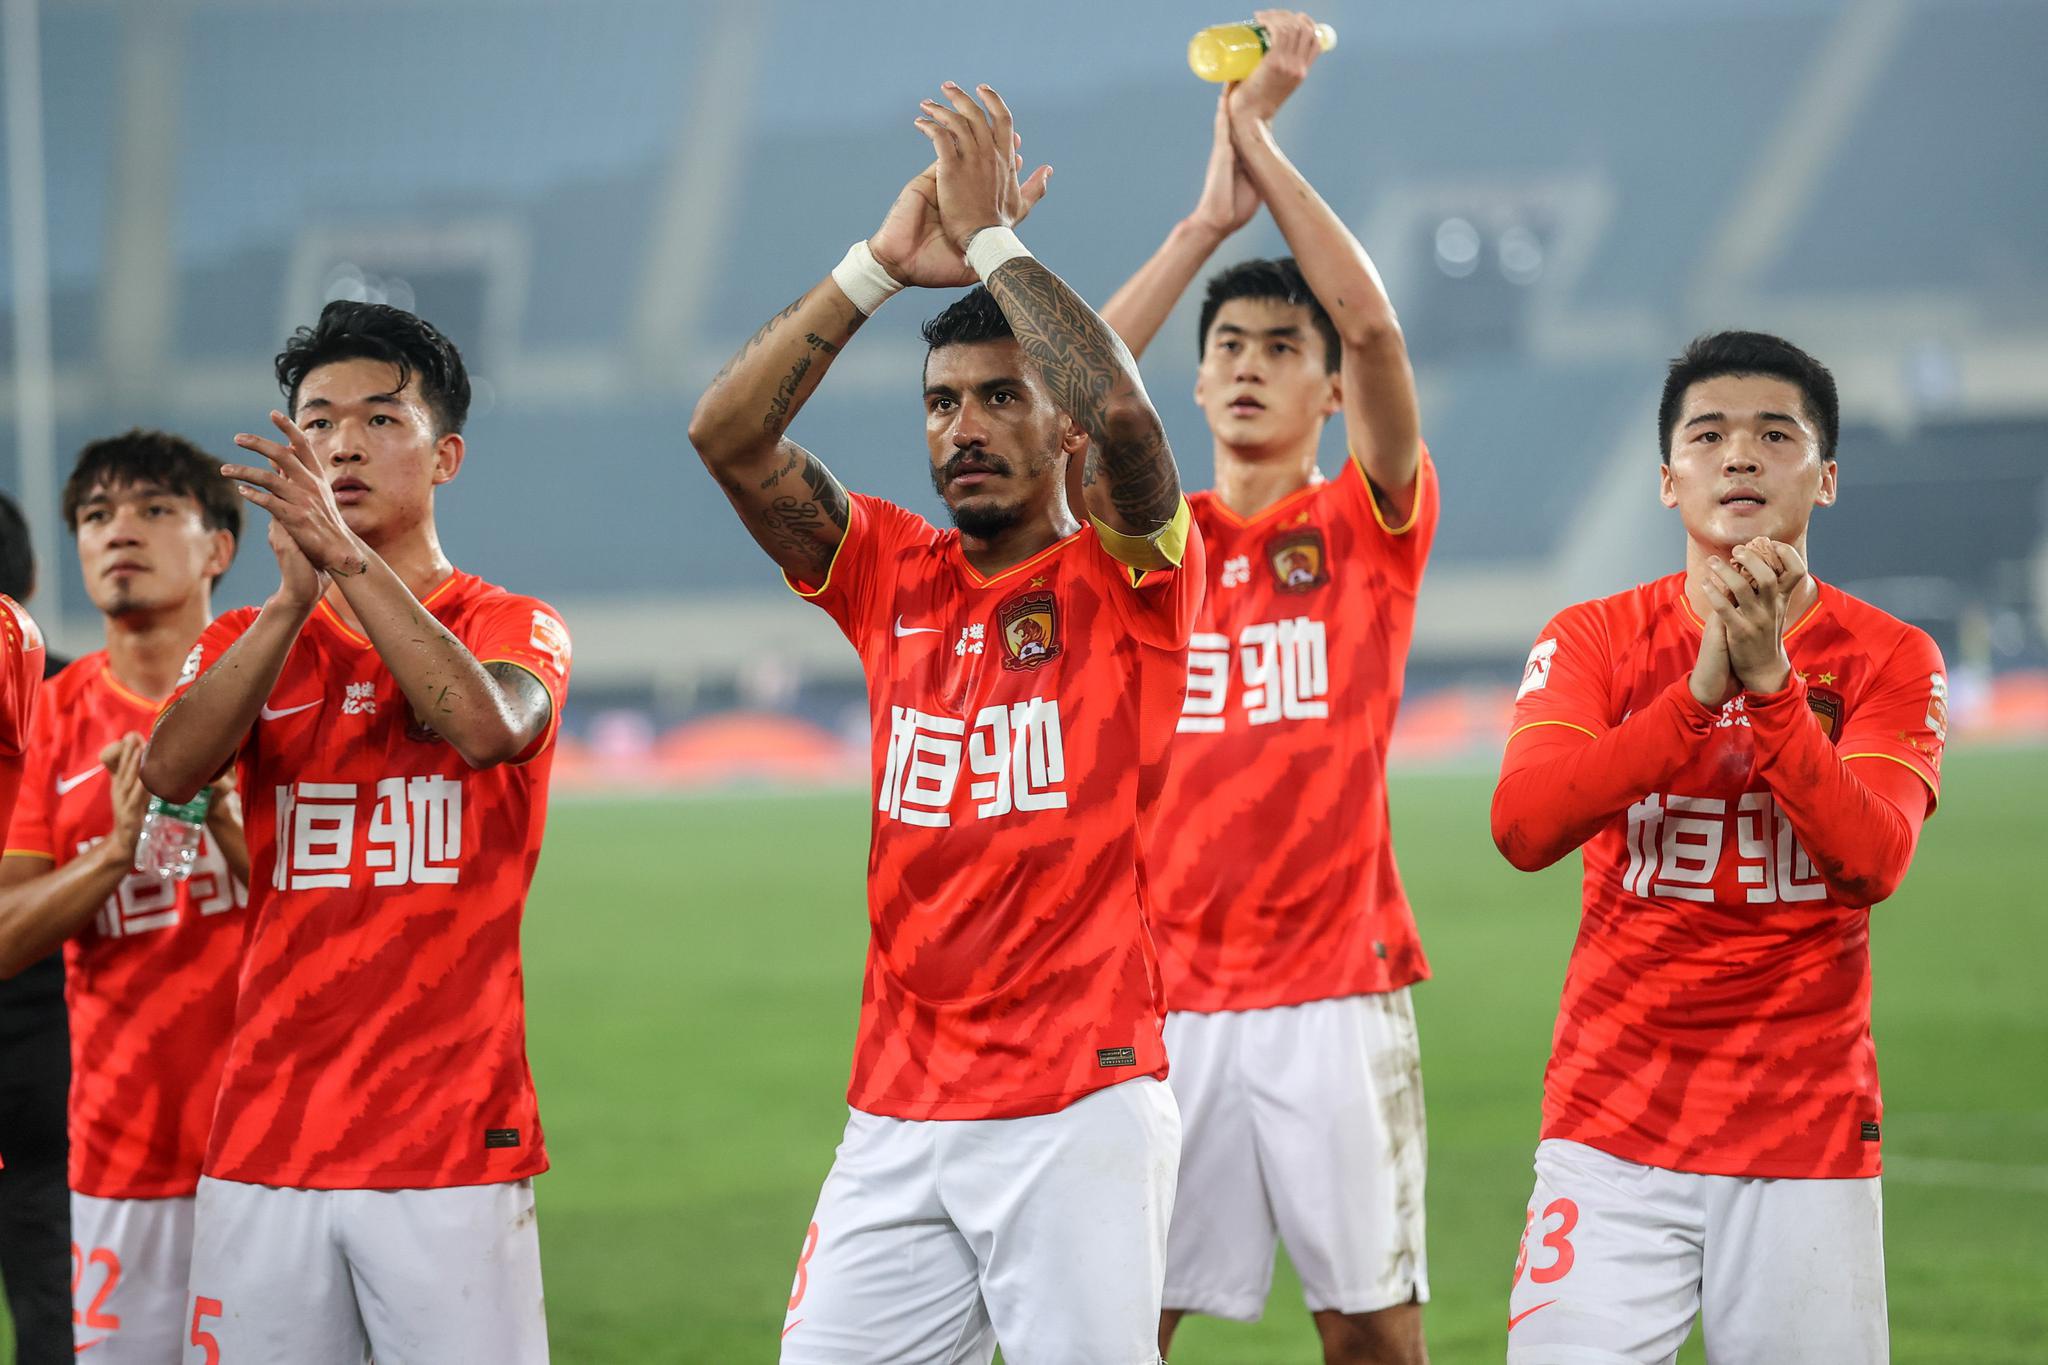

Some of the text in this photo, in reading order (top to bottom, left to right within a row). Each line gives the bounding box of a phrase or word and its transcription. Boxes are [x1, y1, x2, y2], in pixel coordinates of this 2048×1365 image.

[878, 697, 1068, 828] 恒驰
[272, 774, 462, 891] 恒驰
[1512, 1197, 1579, 1290] 3
